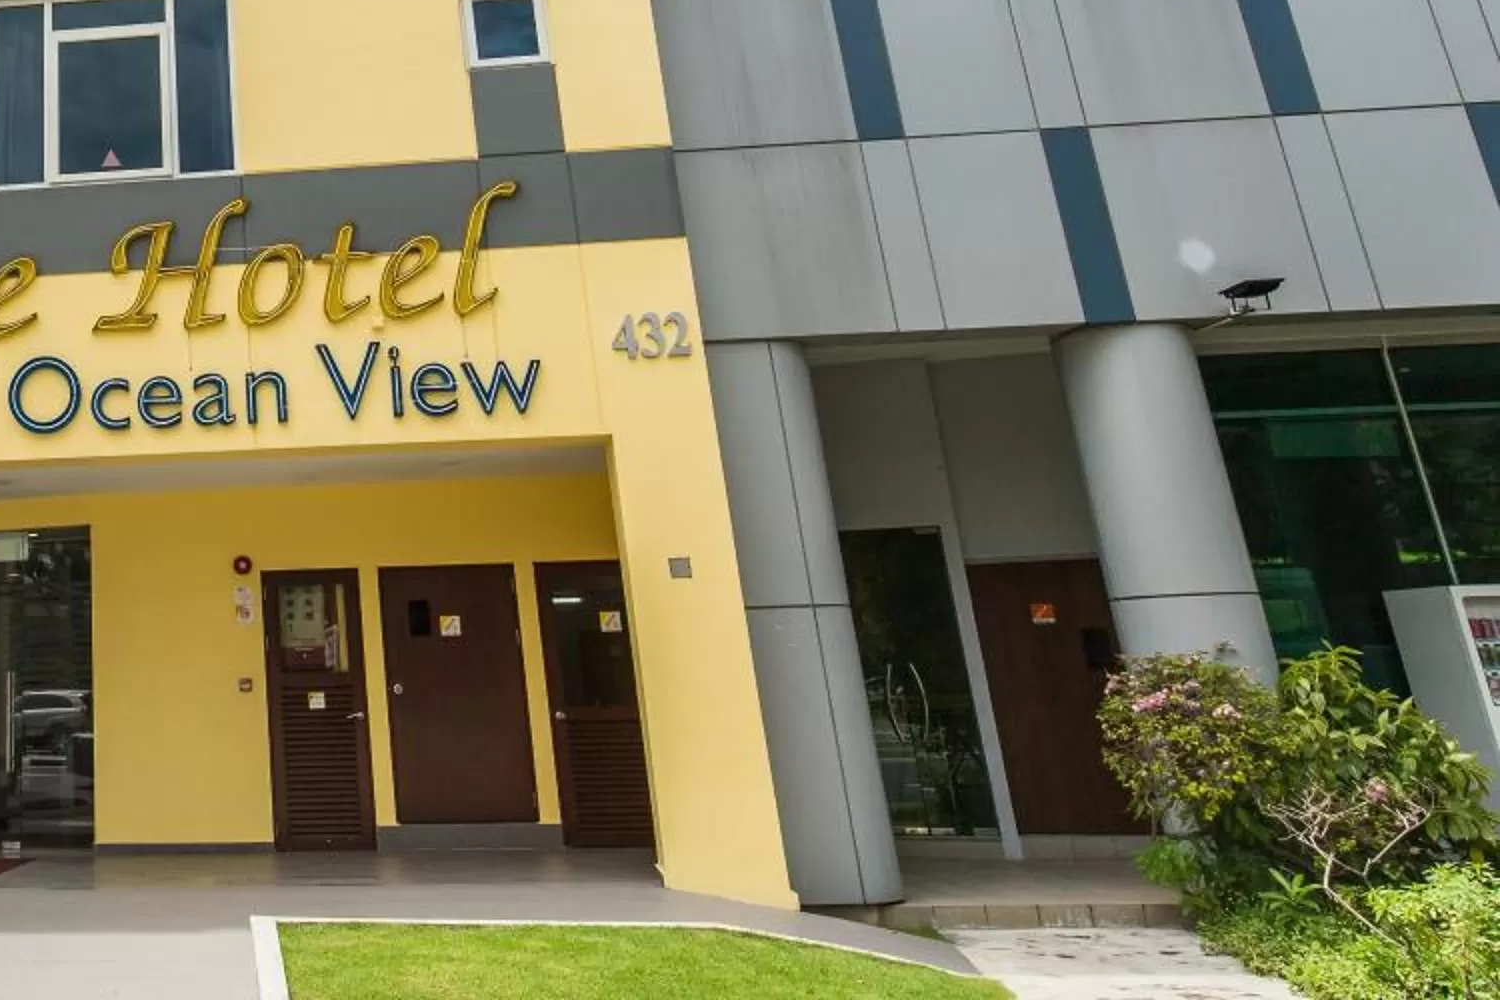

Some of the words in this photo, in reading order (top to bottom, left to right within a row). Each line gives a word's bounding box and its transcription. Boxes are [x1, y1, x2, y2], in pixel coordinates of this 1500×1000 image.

[91, 179, 517, 334] Hotel
[612, 311, 692, 360] 432
[7, 355, 288, 434] Ocean
[315, 340, 541, 420] View
